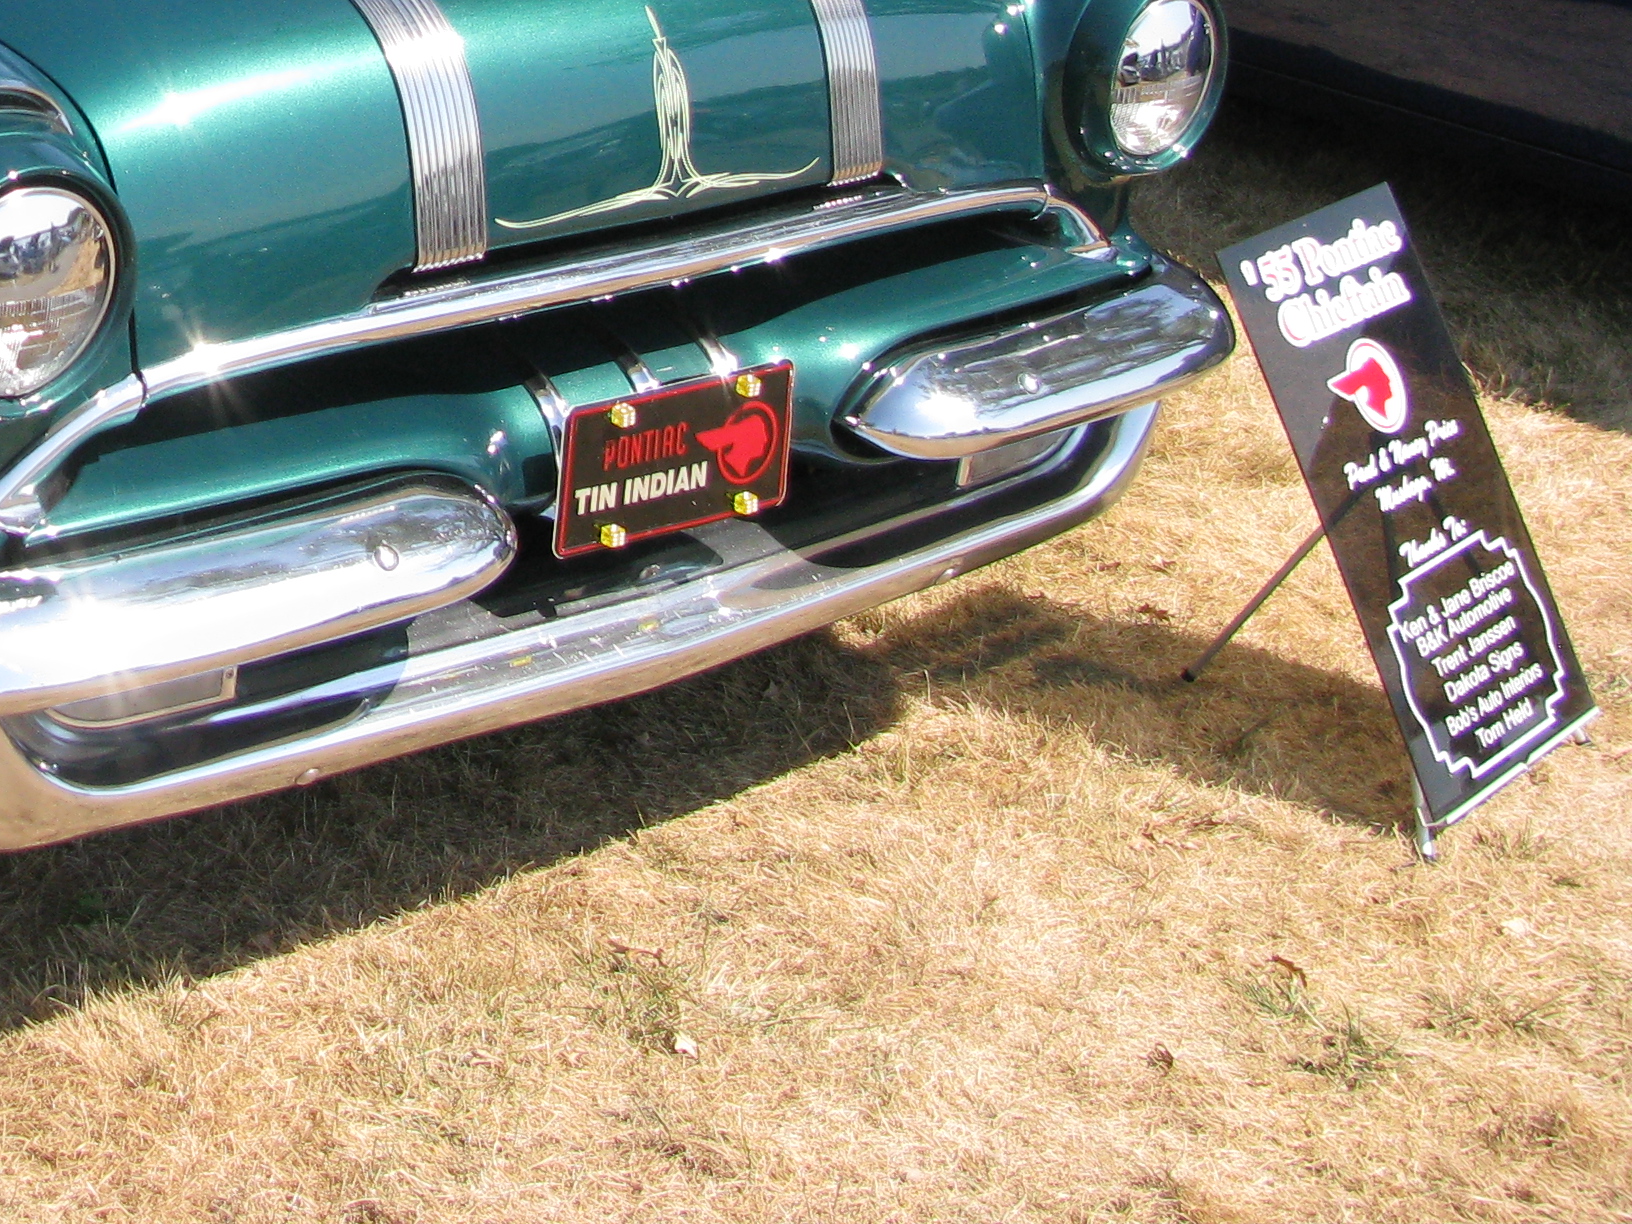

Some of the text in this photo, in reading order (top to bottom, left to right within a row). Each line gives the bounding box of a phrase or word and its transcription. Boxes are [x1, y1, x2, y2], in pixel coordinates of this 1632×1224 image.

[1240, 218, 1402, 302] '55 Pontiac
[1277, 265, 1412, 348] Chieftain
[603, 421, 690, 472] PONTIAC
[574, 460, 708, 516] TIN INDIAN
[1398, 527, 1447, 568] Thanks
[1398, 560, 1516, 643] Ken & Jane Briscoe
[1415, 587, 1513, 658] B&K Automotive
[1430, 615, 1517, 678] Trent Janssen
[1443, 641, 1525, 703] Dakota Signs
[1445, 662, 1544, 737] Bob's Auto Interiors
[1474, 697, 1534, 748] Tom Held
